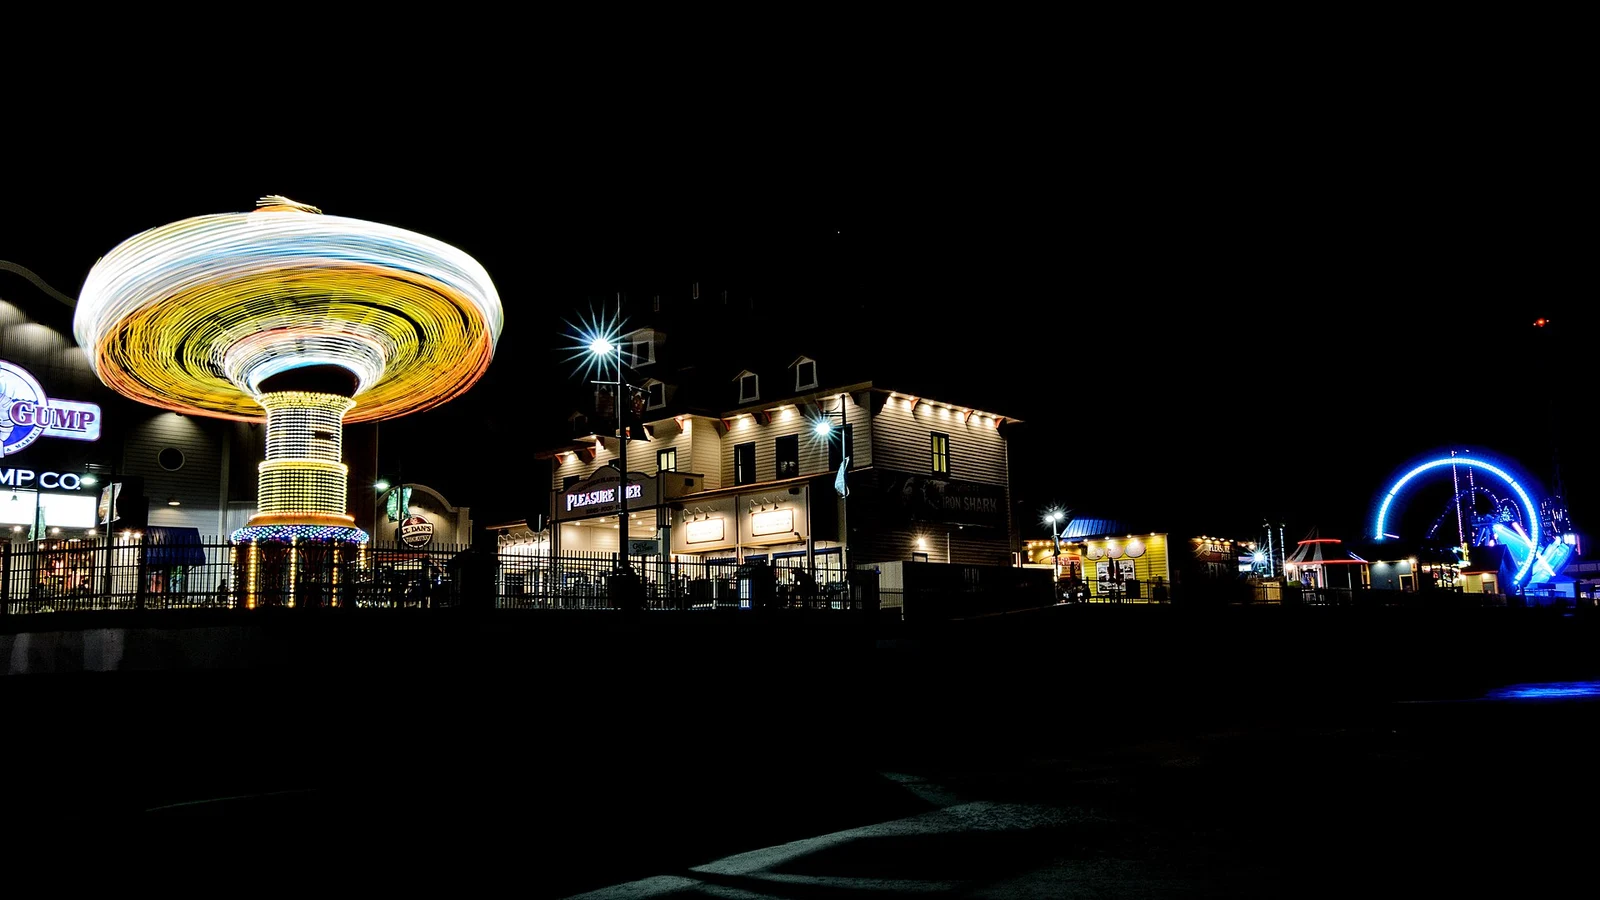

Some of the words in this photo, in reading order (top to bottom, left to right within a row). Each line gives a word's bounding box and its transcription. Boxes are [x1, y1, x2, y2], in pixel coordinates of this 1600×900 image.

[11, 401, 96, 430] GUMP
[39, 471, 81, 490] CO.
[567, 488, 615, 511] PLEASURE
[942, 494, 961, 509] IRON
[963, 496, 997, 513] SHARK
